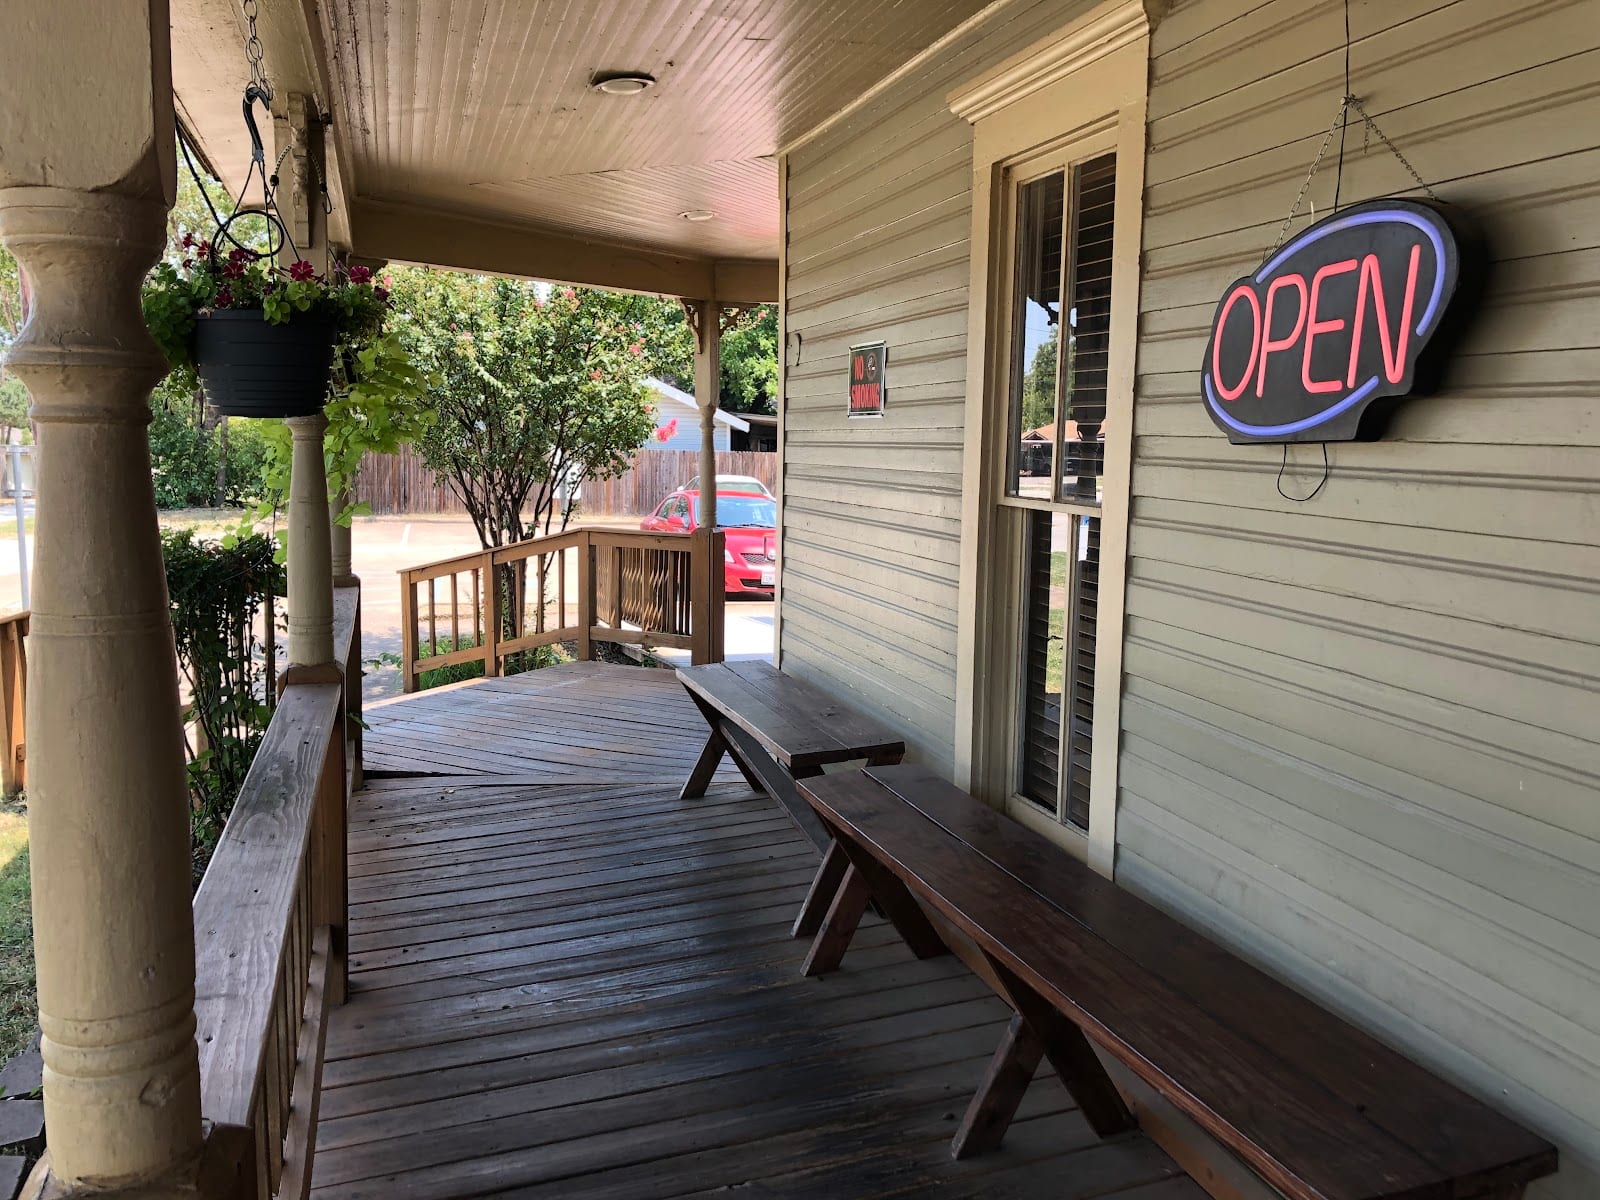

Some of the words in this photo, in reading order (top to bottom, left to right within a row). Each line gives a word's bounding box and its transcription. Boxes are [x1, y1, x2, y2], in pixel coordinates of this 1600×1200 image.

[1212, 244, 1421, 400] OPEN
[854, 355, 865, 380] NO
[851, 383, 880, 408] SMOKING
